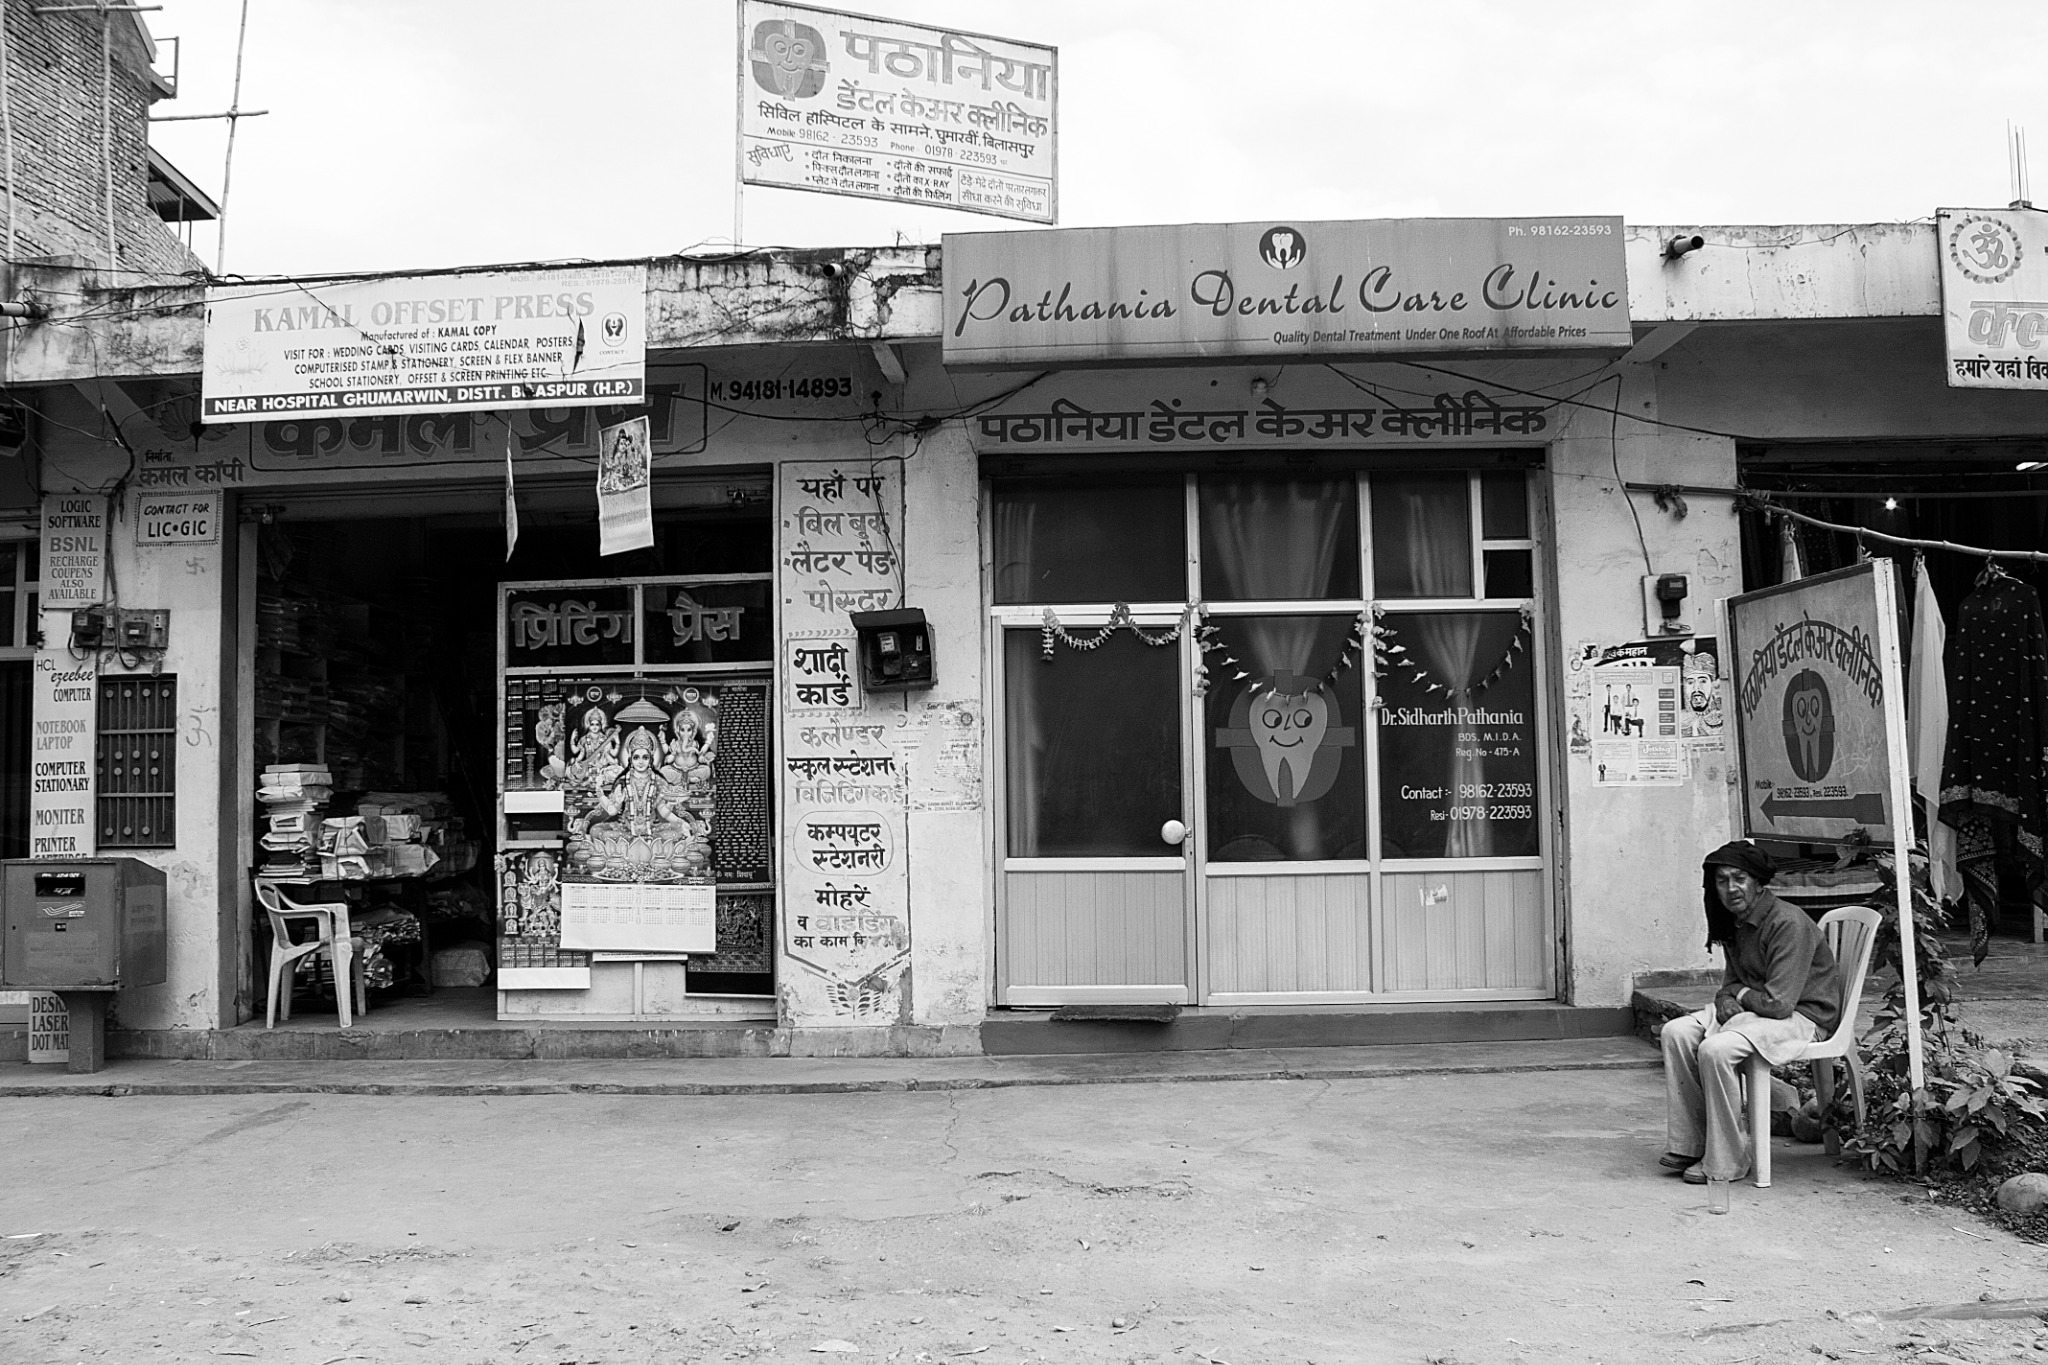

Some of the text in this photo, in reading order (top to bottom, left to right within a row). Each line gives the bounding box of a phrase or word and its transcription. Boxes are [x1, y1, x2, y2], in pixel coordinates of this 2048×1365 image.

[840, 29, 1051, 101] पठानिया
[837, 78, 897, 116] डेंटल
[967, 100, 1048, 138] क्लीनिक
[757, 100, 1035, 158] सिविल के बिलासपुर
[890, 141, 915, 152] Phone
[1508, 225, 1612, 237] Ph. 98162-23593
[955, 263, 1619, 337] Pathania Dental Care Clinic
[254, 292, 595, 332] KAMAL OFFSET PRESS
[361, 324, 497, 342] Manufactured of KAMAL COPY
[1274, 325, 1586, 345] Quality Dental Treatment Under One Roof At Affordable Prices
[284, 349, 305, 360] VISIT
[308, 348, 324, 360] FOR
[333, 345, 373, 358] WEDDING
[409, 342, 448, 354] VISITING
[294, 360, 358, 375] COMPUTERISED
[361, 359, 389, 372] STAMP
[460, 354, 492, 367] SCREEN
[495, 353, 501, 365] &
[504, 353, 524, 365] FLEX
[1953, 354, 1991, 382] हमारे
[309, 376, 343, 389] SCHOOL
[408, 371, 437, 384] OFFSET
[441, 371, 446, 383] &
[450, 369, 482, 383] SCREEN
[485, 368, 528, 381] PRINTING
[214, 397, 257, 413] NEAR
[262, 393, 338, 410] HOSPITAL
[343, 388, 452, 406] GHUMARWIN,
[457, 387, 506, 401] DISTT.
[593, 379, 634, 396] (H.P.)
[976, 390, 1548, 444] पठानिया डेंटल केअर क्लीनिक
[139, 457, 246, 486] कमल कॉपी
[852, 475, 888, 499] पर
[61, 500, 91, 513] LOGIC
[144, 503, 210, 516] CONTACT FOR
[48, 515, 101, 529] SOFTWARE
[793, 506, 846, 537] बिल
[50, 536, 98, 552] BSNL
[50, 555, 98, 567] RECHARGE
[51, 567, 93, 579] COUPENS
[60, 579, 84, 588] ALSO
[48, 588, 97, 600] AVAILABLE
[511, 600, 634, 650] प्रिंटिंग
[36, 659, 56, 671] HCL
[793, 642, 849, 679] शादी
[1741, 637, 1778, 721] पठानिया
[1774, 622, 1805, 669] डेंटल
[1803, 609, 1836, 664] केअर
[1835, 625, 1884, 709] क्लीनिक
[53, 688, 91, 702] COMPUTER
[795, 674, 853, 707] कार्ड
[1457, 707, 1524, 725] Pathania
[36, 719, 86, 735] NOTEBOOK
[36, 736, 73, 750] LAPTOP
[35, 761, 86, 776] COMPUTER
[786, 757, 831, 781] स्कूल
[35, 777, 90, 792] STATIONARY
[1459, 783, 1533, 799] 98162-23593
[35, 808, 85, 825] MONITER
[1450, 805, 1533, 821] 01978-223593
[35, 836, 76, 852] PRINTER
[812, 843, 886, 871] स्टेशनरी
[814, 882, 871, 911] मोहरें
[797, 915, 809, 931] व
[794, 936, 851, 949] का काम
[32, 1015, 69, 1032] LASER
[32, 1033, 51, 1051] DOT
